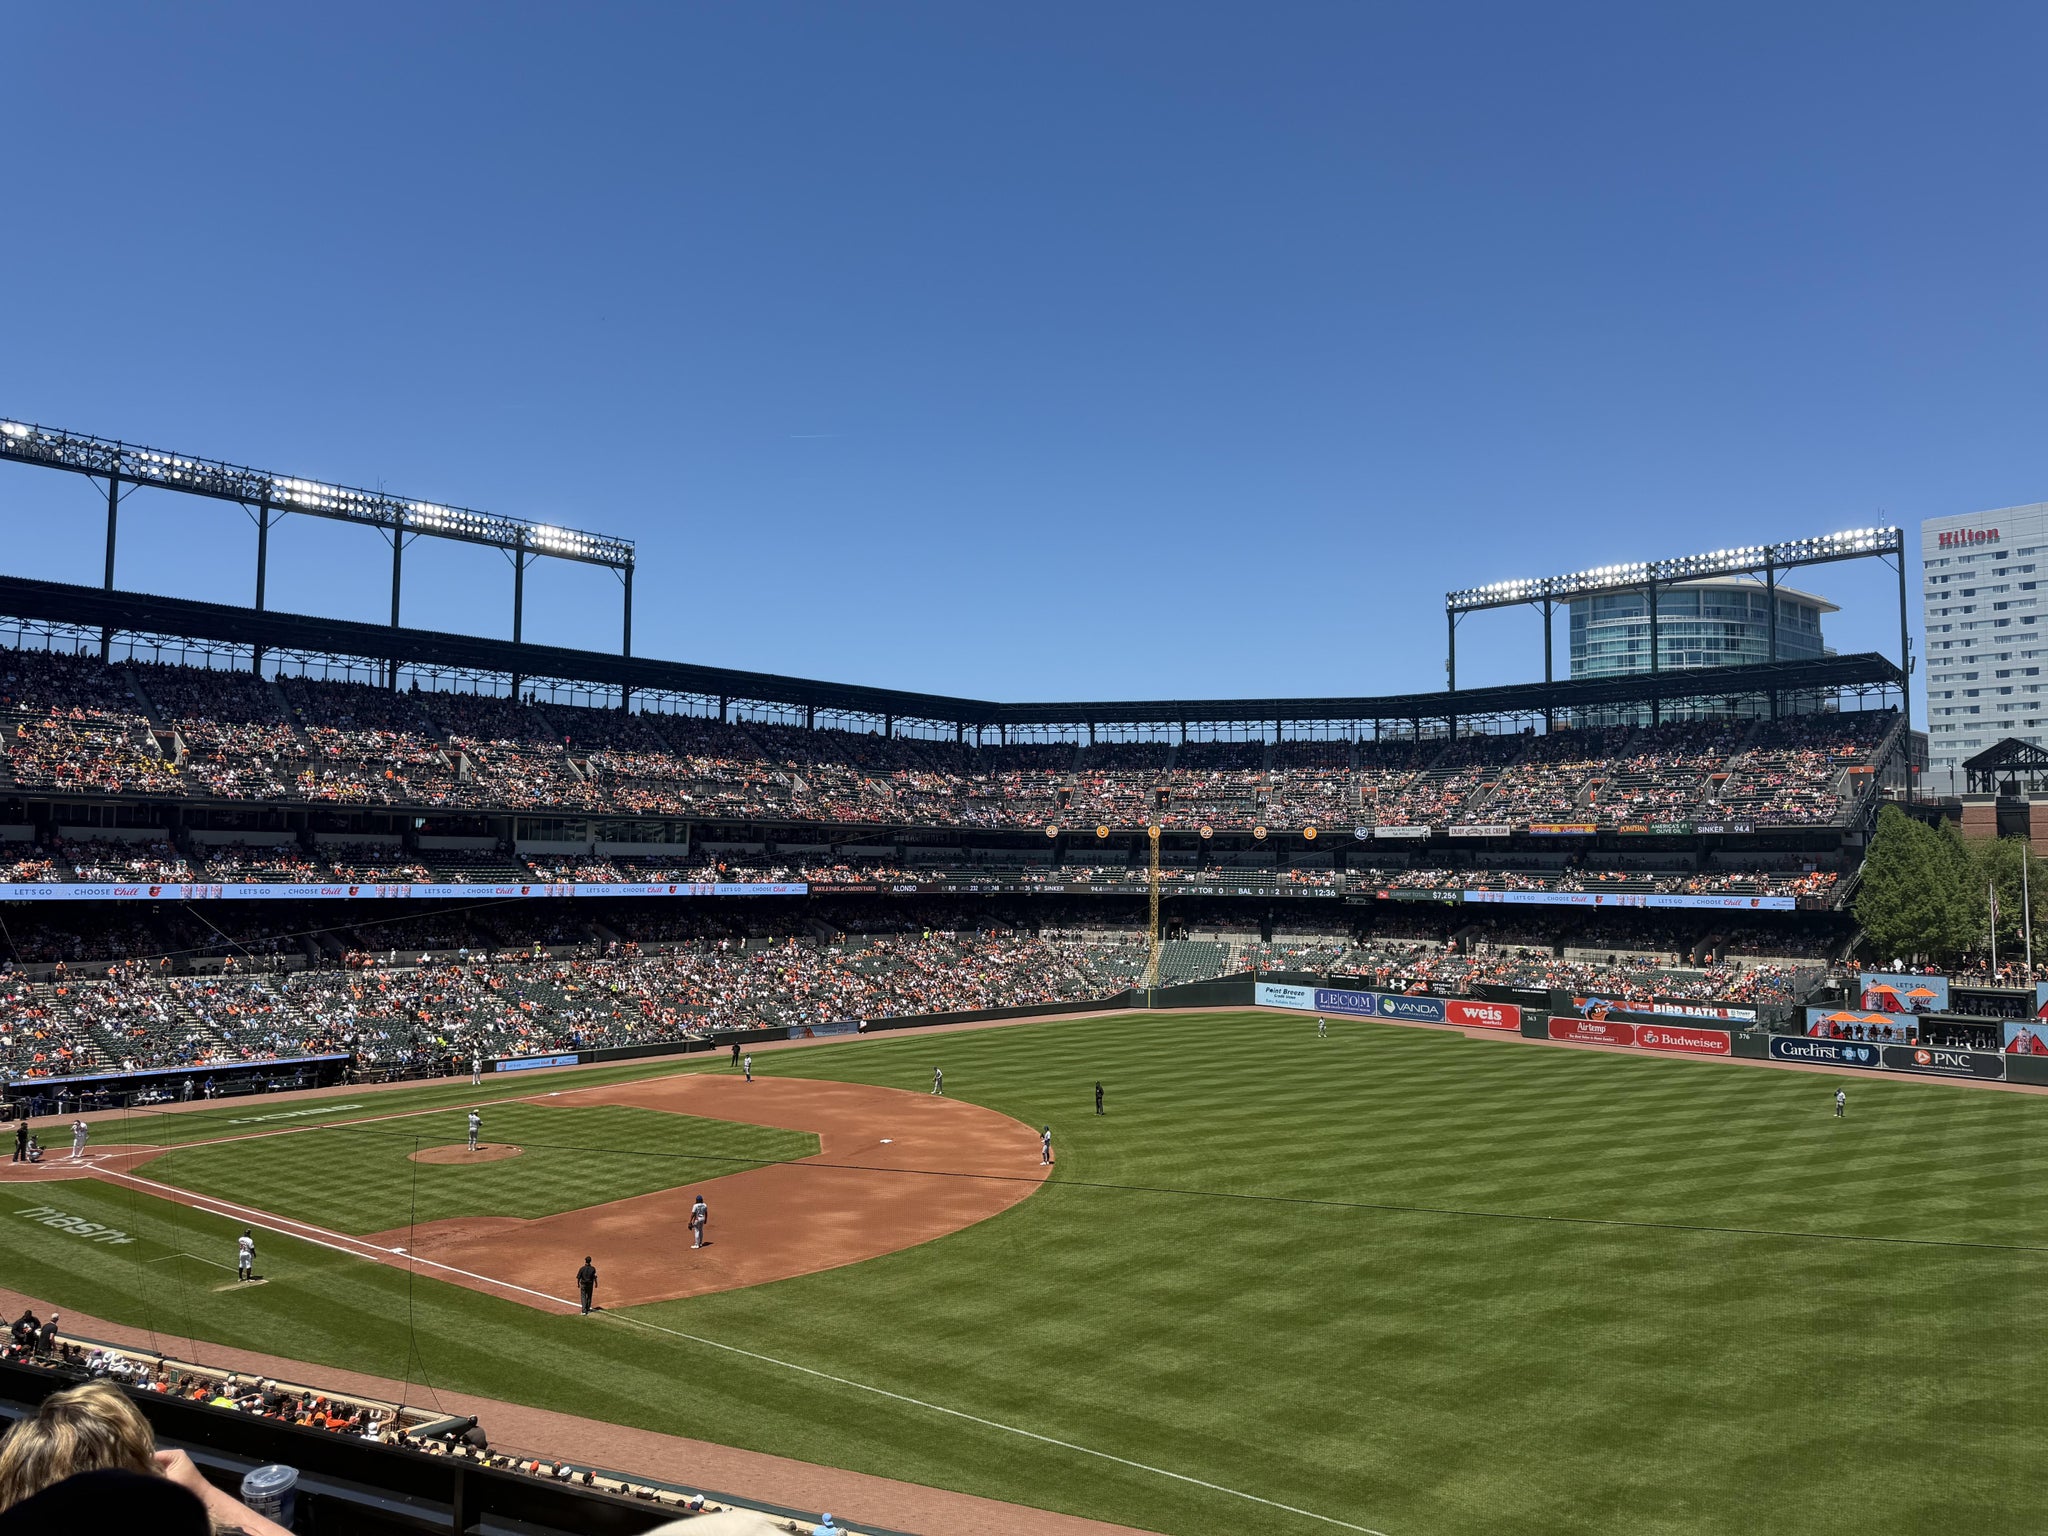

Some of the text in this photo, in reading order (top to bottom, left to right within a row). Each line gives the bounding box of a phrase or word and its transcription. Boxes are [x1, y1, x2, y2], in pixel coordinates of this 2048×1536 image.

[1938, 528, 2000, 545] Hilton
[114, 888, 139, 896] Chill
[1283, 988, 1305, 996] Breeze
[1320, 993, 1370, 1008] LECOM
[1396, 1002, 1439, 1015] VANDA
[1463, 1007, 1502, 1020] weis
[1654, 1003, 1717, 1017] BIRD BATH
[1578, 1022, 1606, 1034] Airtemp
[1781, 1042, 1840, 1059] CareFirst
[1934, 1052, 1970, 1067] PNC
